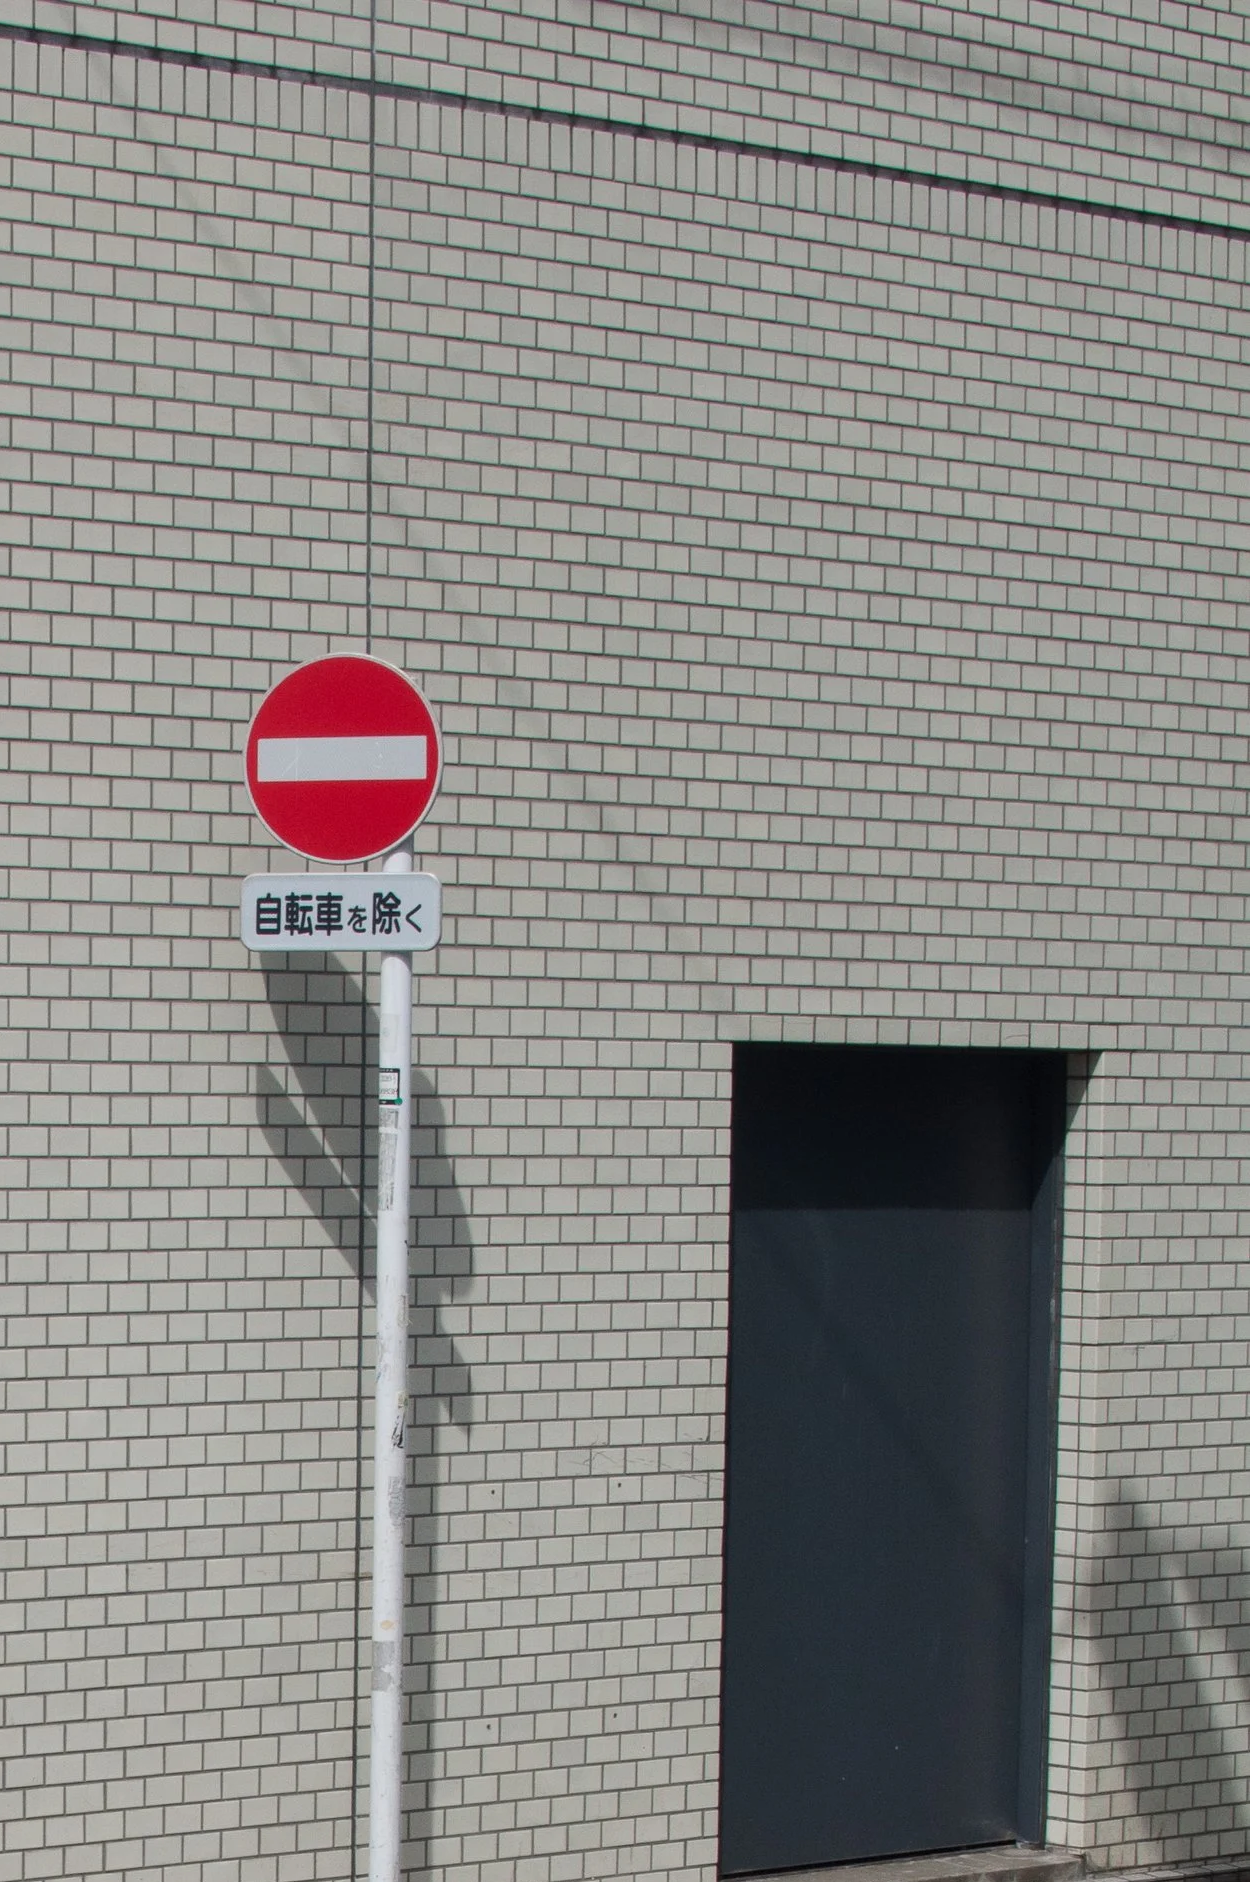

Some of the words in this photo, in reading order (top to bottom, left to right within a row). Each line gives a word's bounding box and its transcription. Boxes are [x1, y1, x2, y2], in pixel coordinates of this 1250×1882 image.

[255, 891, 423, 937] 自転車を除く
